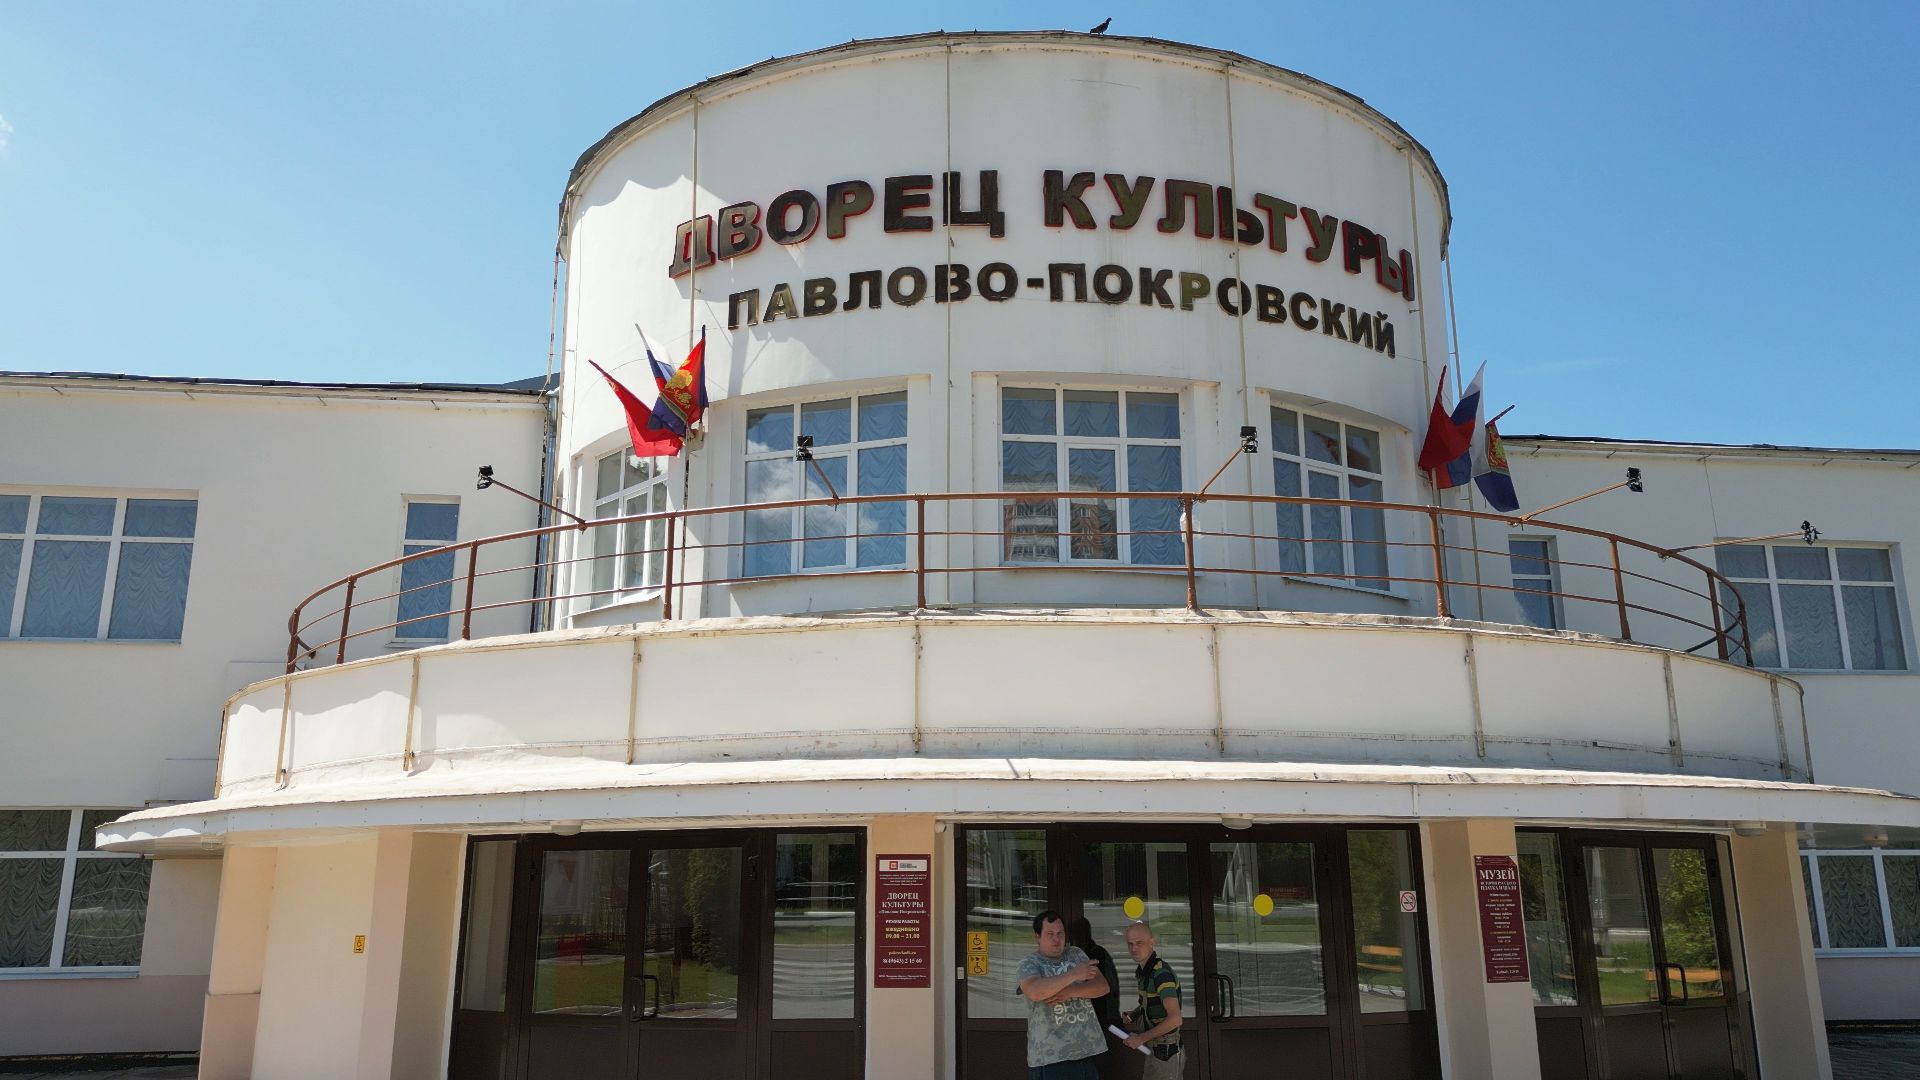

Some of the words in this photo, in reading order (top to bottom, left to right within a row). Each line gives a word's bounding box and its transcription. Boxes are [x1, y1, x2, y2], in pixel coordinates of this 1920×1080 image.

[668, 169, 1005, 279] ДВОРЕЦ
[1043, 169, 1416, 302] КУЛЬТУРЫ
[727, 261, 1397, 359] ПАВЛОВО-ПОКРОВСКИЙ
[1480, 868, 1515, 880] МУЗЕЙ
